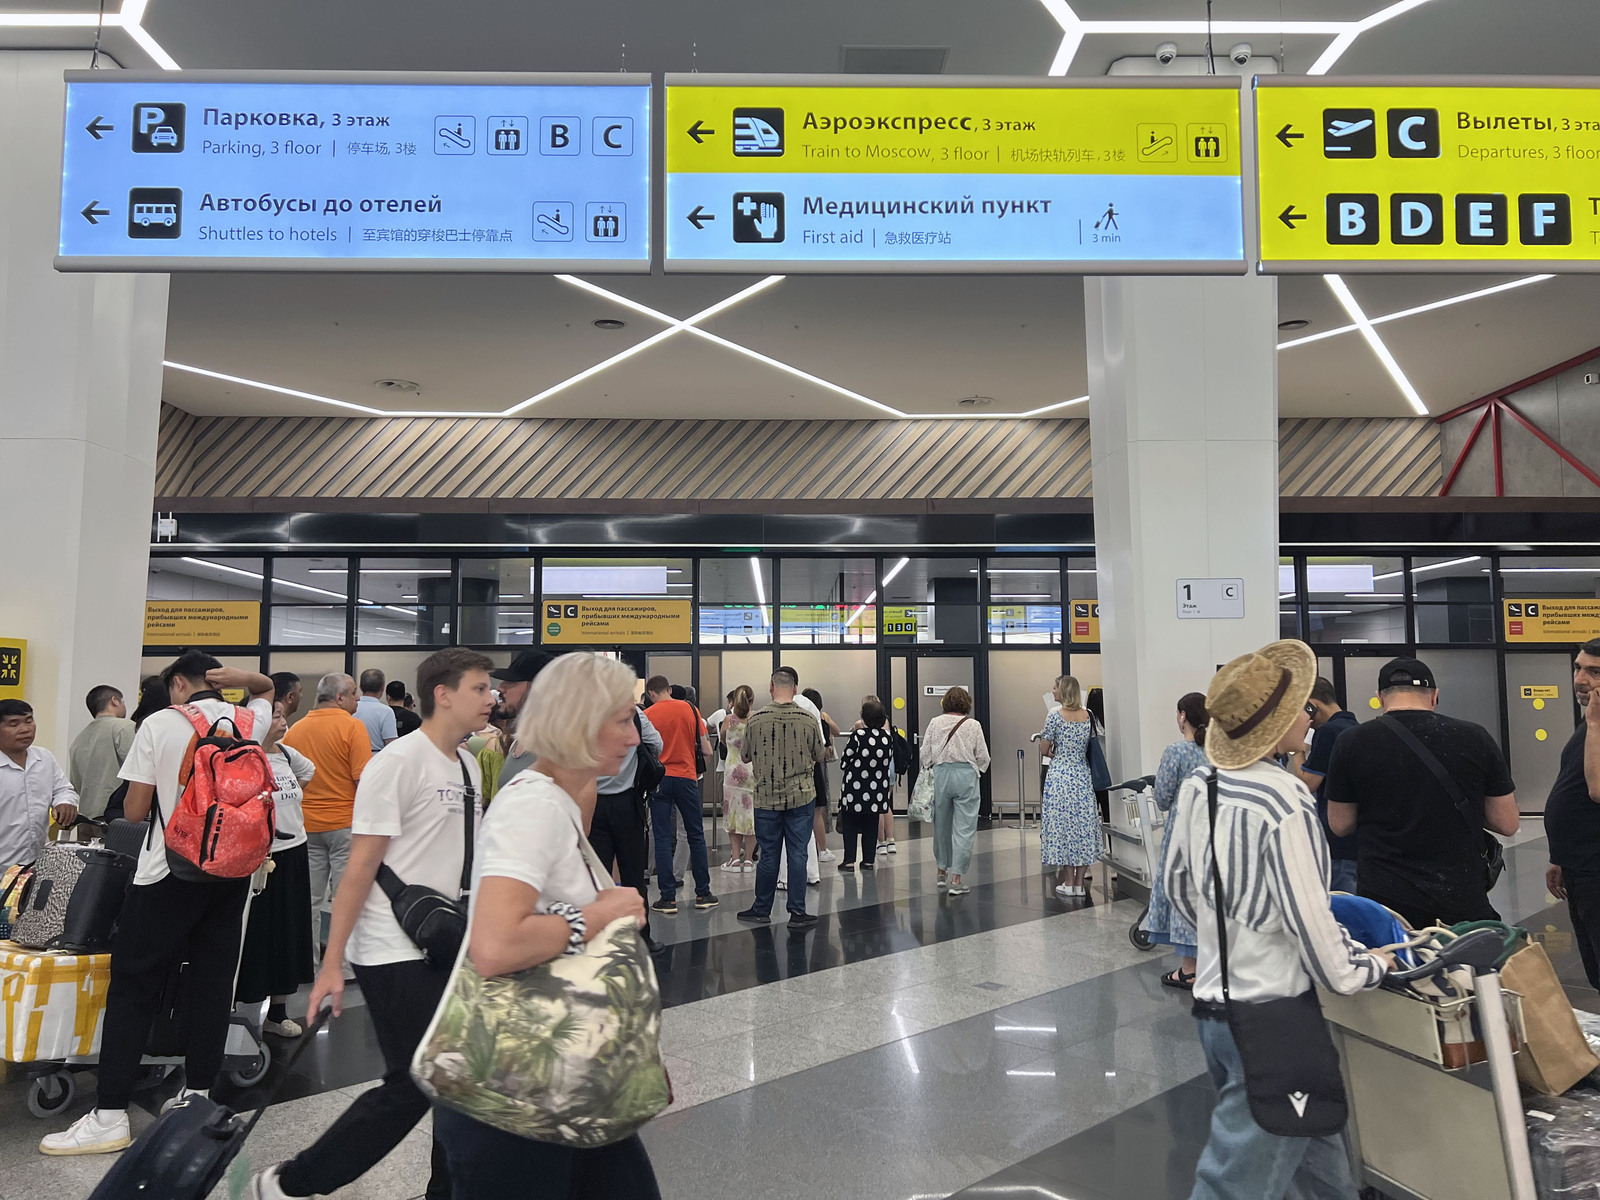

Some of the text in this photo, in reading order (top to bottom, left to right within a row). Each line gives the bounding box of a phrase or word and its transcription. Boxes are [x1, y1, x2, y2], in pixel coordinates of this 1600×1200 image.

[139, 107, 165, 134] P
[203, 108, 390, 130] Парковка, 3 этаж
[802, 112, 1036, 134] Аэроэкспресс, 3 этаж
[1457, 112, 1557, 132] Вылеты,
[1561, 118, 1570, 131] 3
[550, 124, 569, 148] B
[603, 125, 623, 148] C
[1399, 116, 1426, 150] C
[202, 140, 321, 158] Parking, 3 floor
[802, 144, 989, 162] Train to Moscow, 3 floor
[1458, 145, 1548, 161] Departures,
[1553, 146, 1561, 159] 3
[199, 194, 442, 216] Автобусы до отелей
[803, 195, 1052, 218] Медицинский пункт
[1339, 202, 1366, 236] B
[1401, 202, 1433, 236] D
[1469, 202, 1494, 236] E
[1533, 202, 1556, 236] F
[199, 227, 337, 241] Shuttles to hotels
[362, 228, 513, 242] 至宾馆的穿梭巴士停靠点
[803, 230, 863, 243] First aid
[884, 231, 952, 245] 急救医疗站
[1092, 233, 1121, 243] 3 min
[1183, 584, 1191, 600] 1
[1225, 587, 1234, 597] C
[148, 606, 170, 614] Выход
[567, 607, 575, 616] C
[1528, 605, 1536, 615] C
[281, 792, 297, 800] Day
